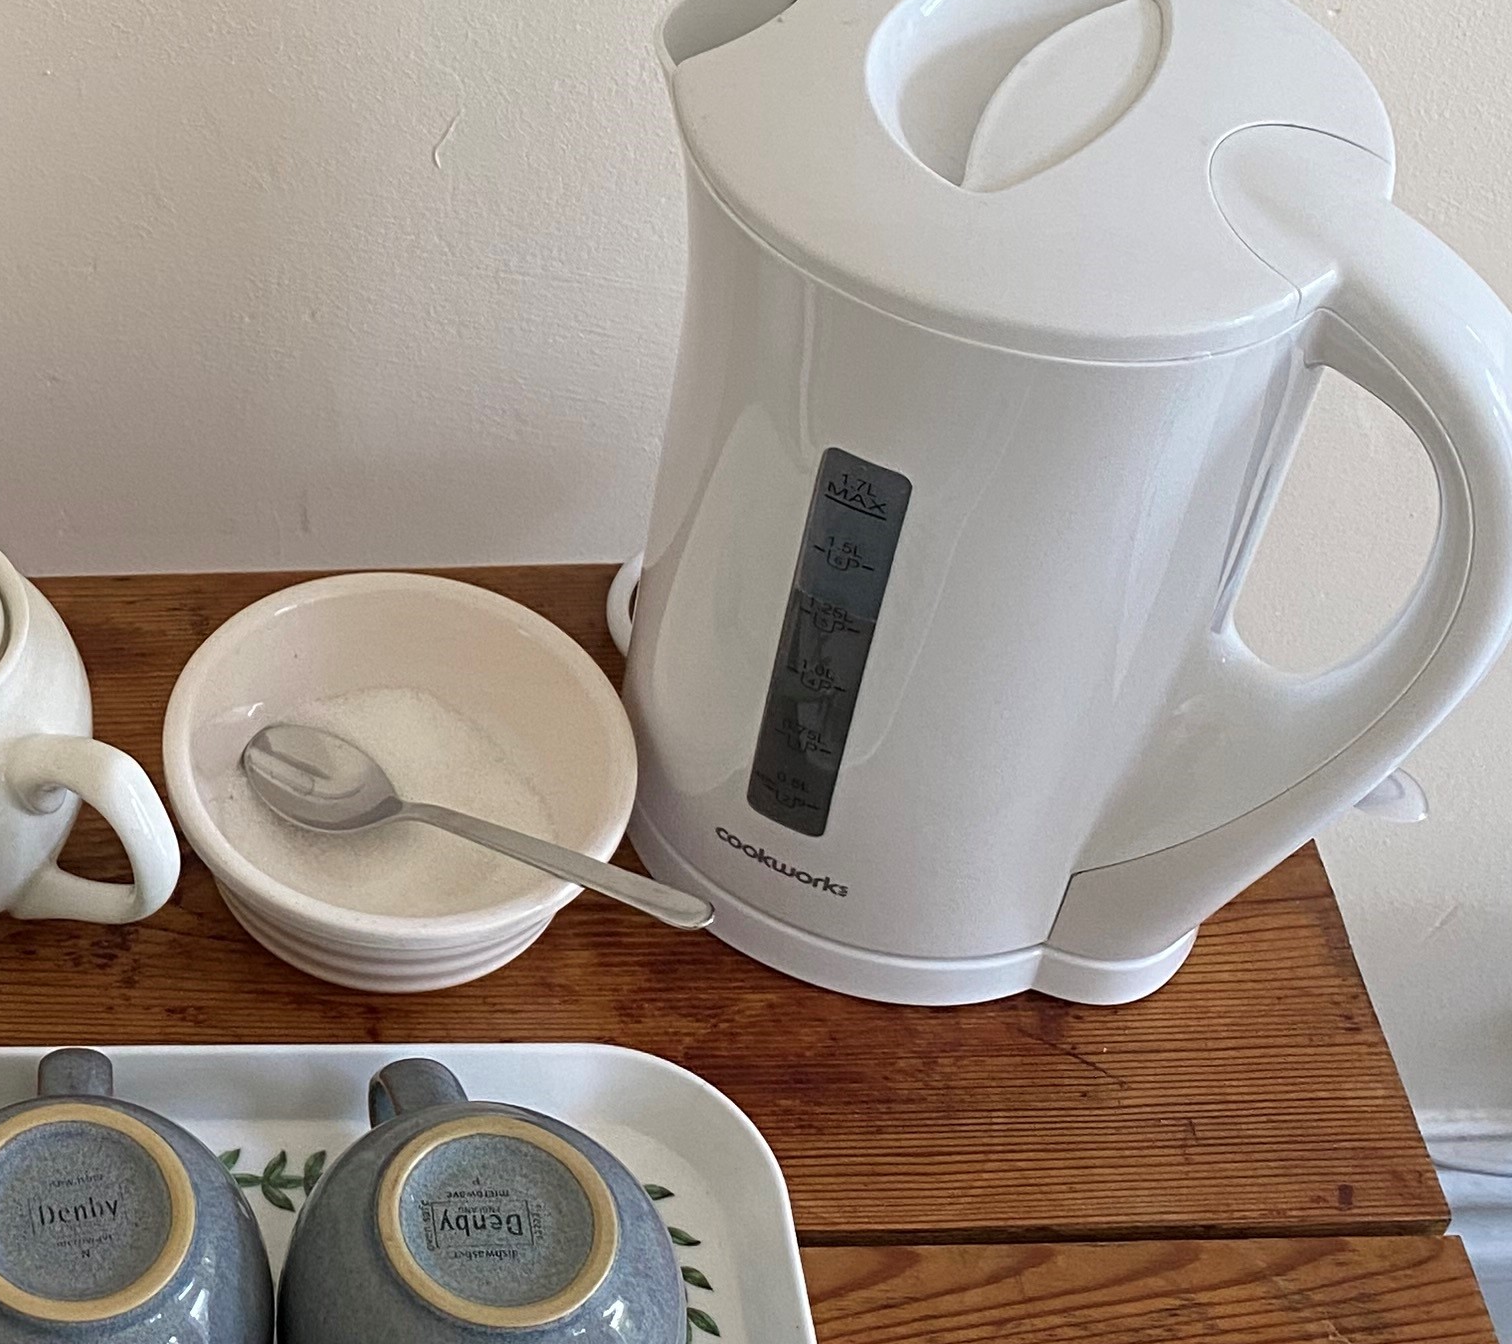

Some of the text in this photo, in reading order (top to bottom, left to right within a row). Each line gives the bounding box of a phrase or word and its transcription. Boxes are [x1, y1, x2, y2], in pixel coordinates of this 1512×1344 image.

[827, 481, 886, 514] MAX
[715, 826, 849, 897] cookworks
[439, 1208, 524, 1237] Denby
